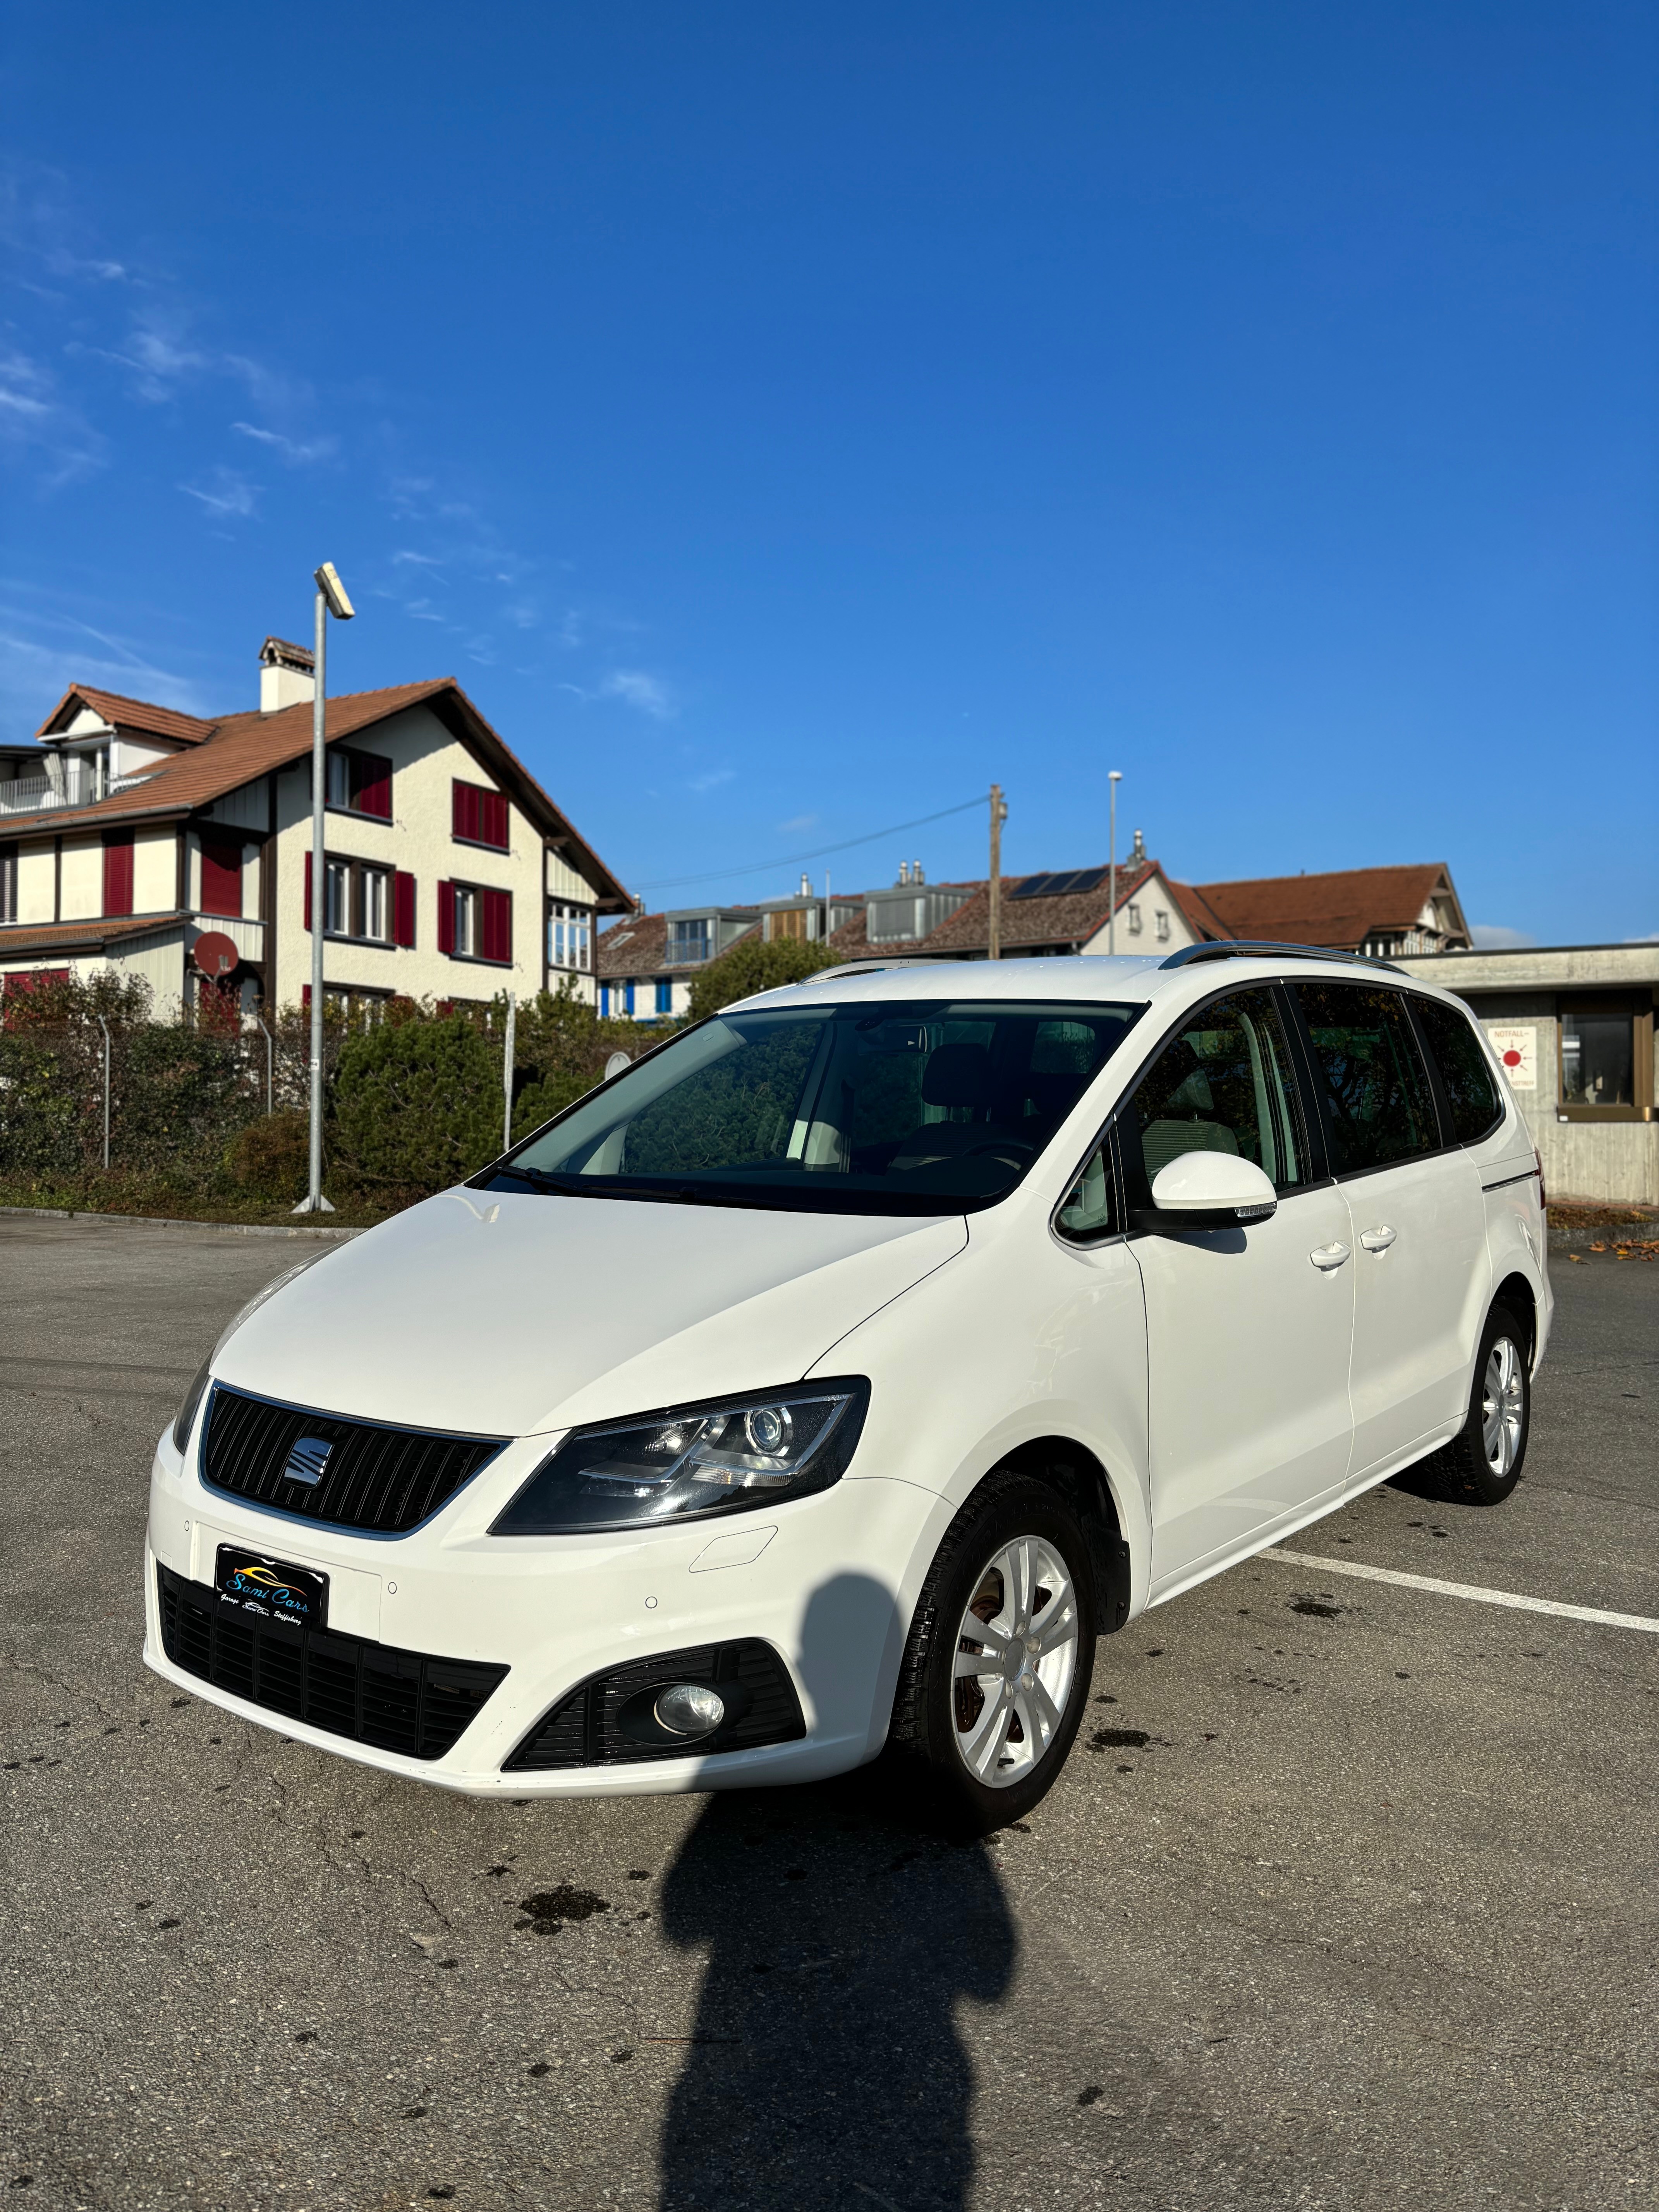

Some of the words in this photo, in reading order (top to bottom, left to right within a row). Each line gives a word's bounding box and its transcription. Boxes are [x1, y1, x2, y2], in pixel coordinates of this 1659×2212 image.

[221, 1594, 239, 1604] Garage
[274, 1611, 301, 1626] Steffisburg
[226, 1574, 270, 1598] Sami
[272, 1589, 309, 1612] Cars
